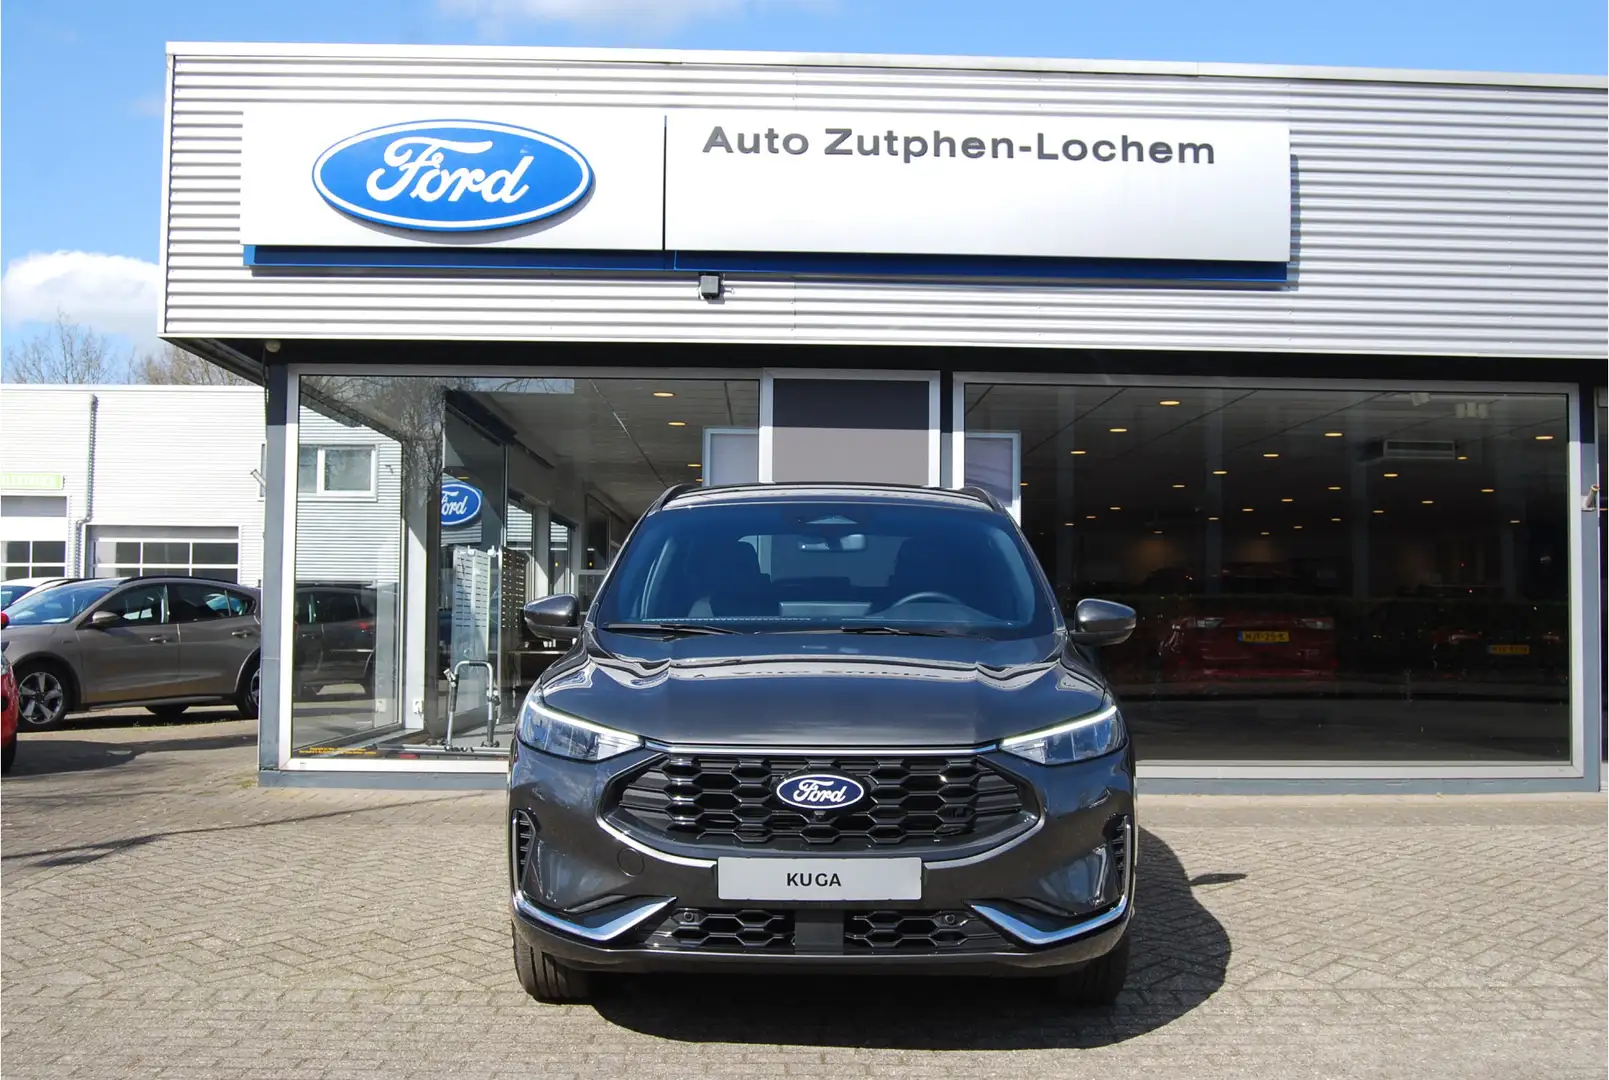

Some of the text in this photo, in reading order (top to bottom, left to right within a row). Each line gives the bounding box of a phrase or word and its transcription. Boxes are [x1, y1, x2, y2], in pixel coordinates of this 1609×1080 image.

[702, 126, 1215, 165] Auto Zutphen-Lochem
[366, 136, 534, 204] Ford
[793, 779, 847, 802] Ford
[786, 872, 842, 887] KUGA
